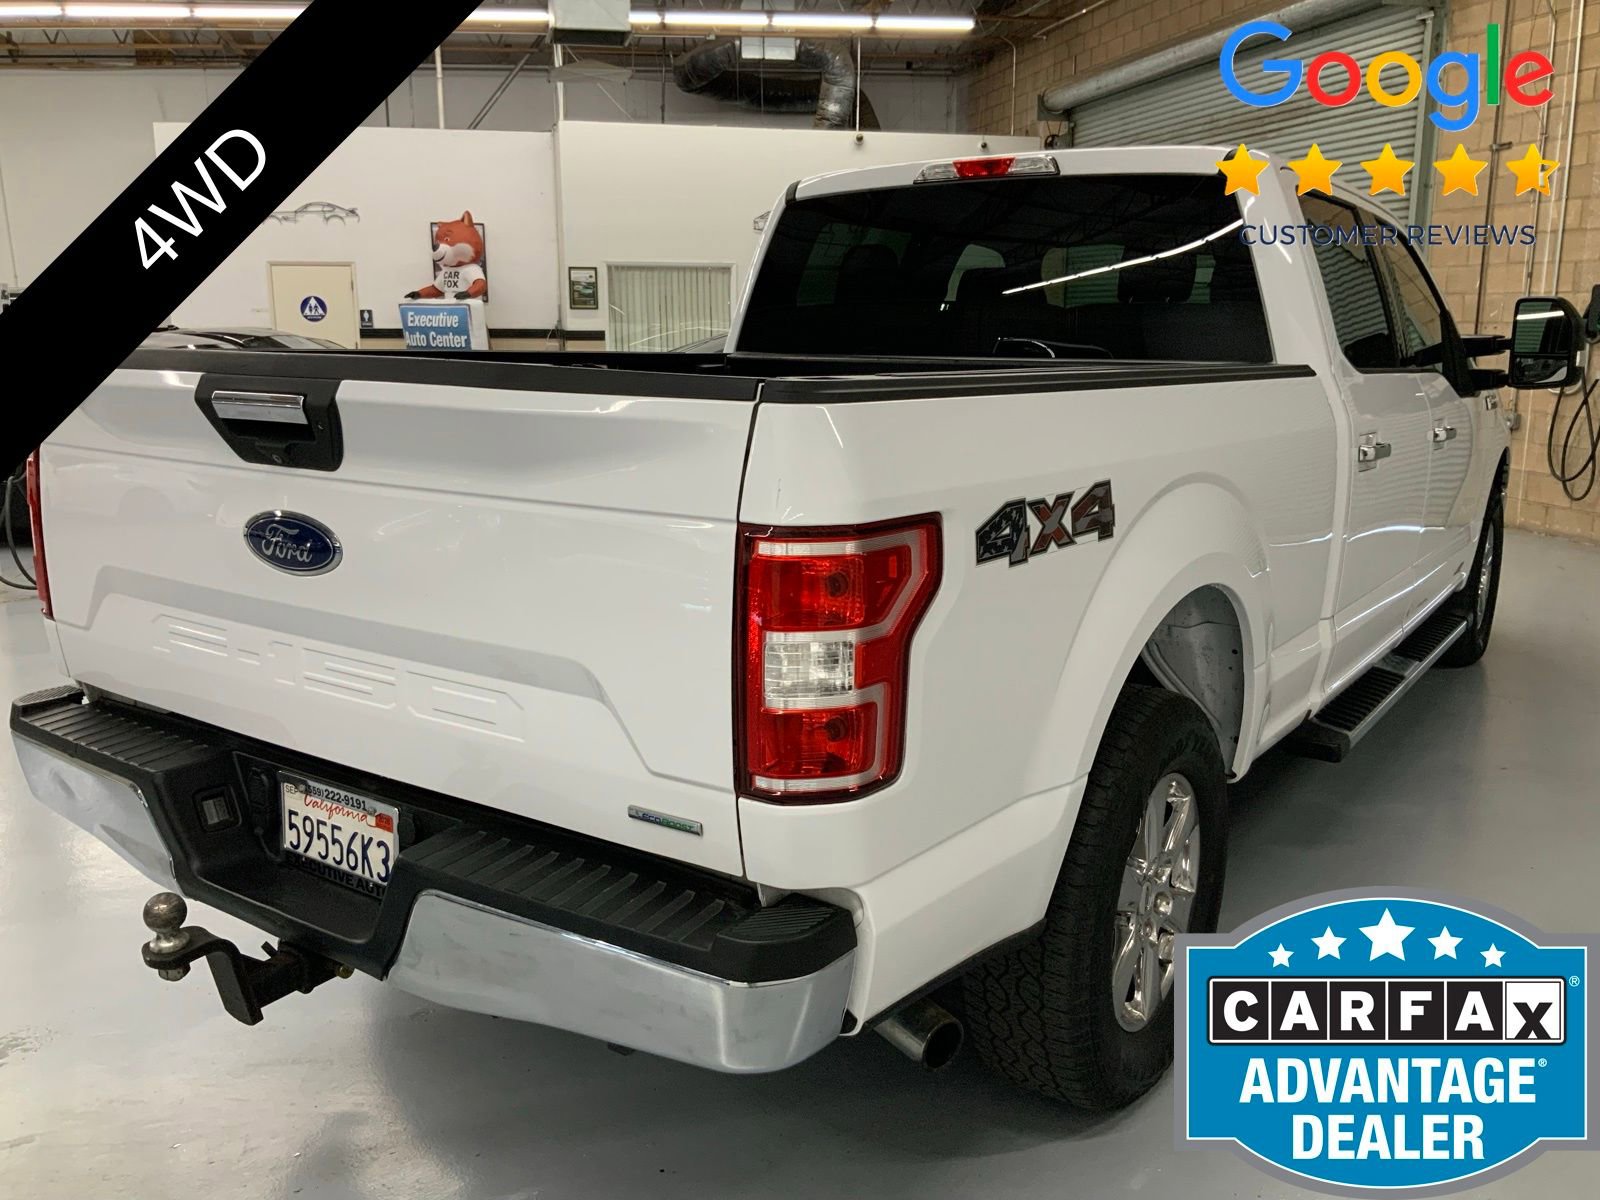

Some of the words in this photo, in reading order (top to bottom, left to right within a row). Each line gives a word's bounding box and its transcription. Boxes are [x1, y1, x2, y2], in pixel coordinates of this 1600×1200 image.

[443, 271, 460, 280] CAR
[443, 280, 459, 288] FOX
[407, 311, 459, 328] Executive
[405, 331, 427, 347] Auto
[429, 331, 467, 348] Center
[261, 523, 313, 563] Ford
[324, 788, 368, 812] 222-9191
[303, 794, 376, 828] California
[287, 808, 391, 883] 59556K3
